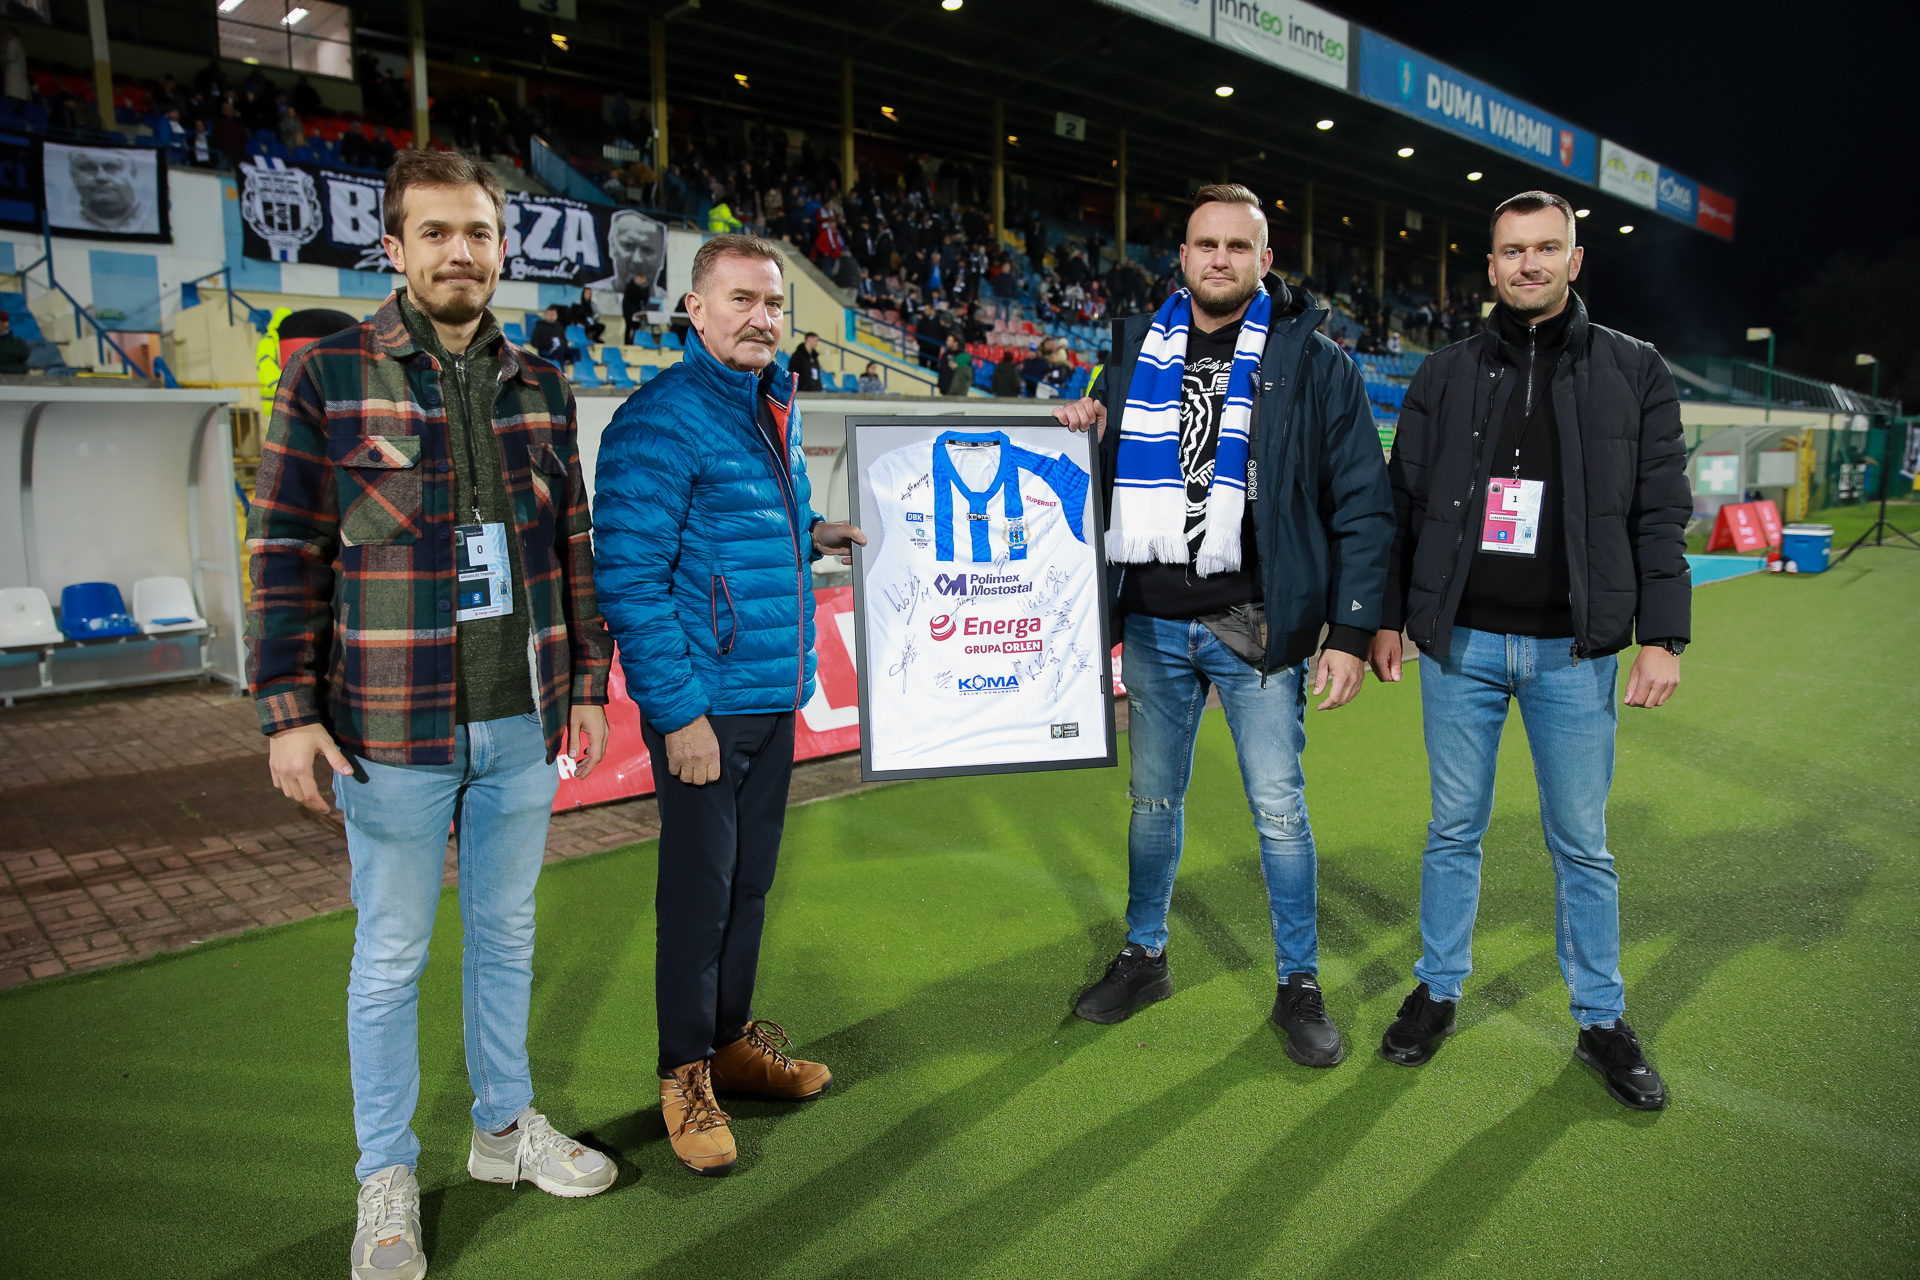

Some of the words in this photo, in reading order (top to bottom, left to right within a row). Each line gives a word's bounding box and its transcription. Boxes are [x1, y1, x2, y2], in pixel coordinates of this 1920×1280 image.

[1427, 72, 1485, 130] DUMA
[1488, 100, 1553, 157] WARMII
[1065, 122, 1077, 137] 2
[1025, 495, 1057, 508] SUPERBET
[908, 513, 922, 521] DBK
[970, 573, 1020, 584] Polimex
[970, 581, 1033, 596] Mostostal
[964, 617, 1041, 639] Energa
[964, 644, 1002, 655] GRUPA
[1004, 641, 1040, 652] ORLEN
[958, 674, 1019, 691] KOMA
